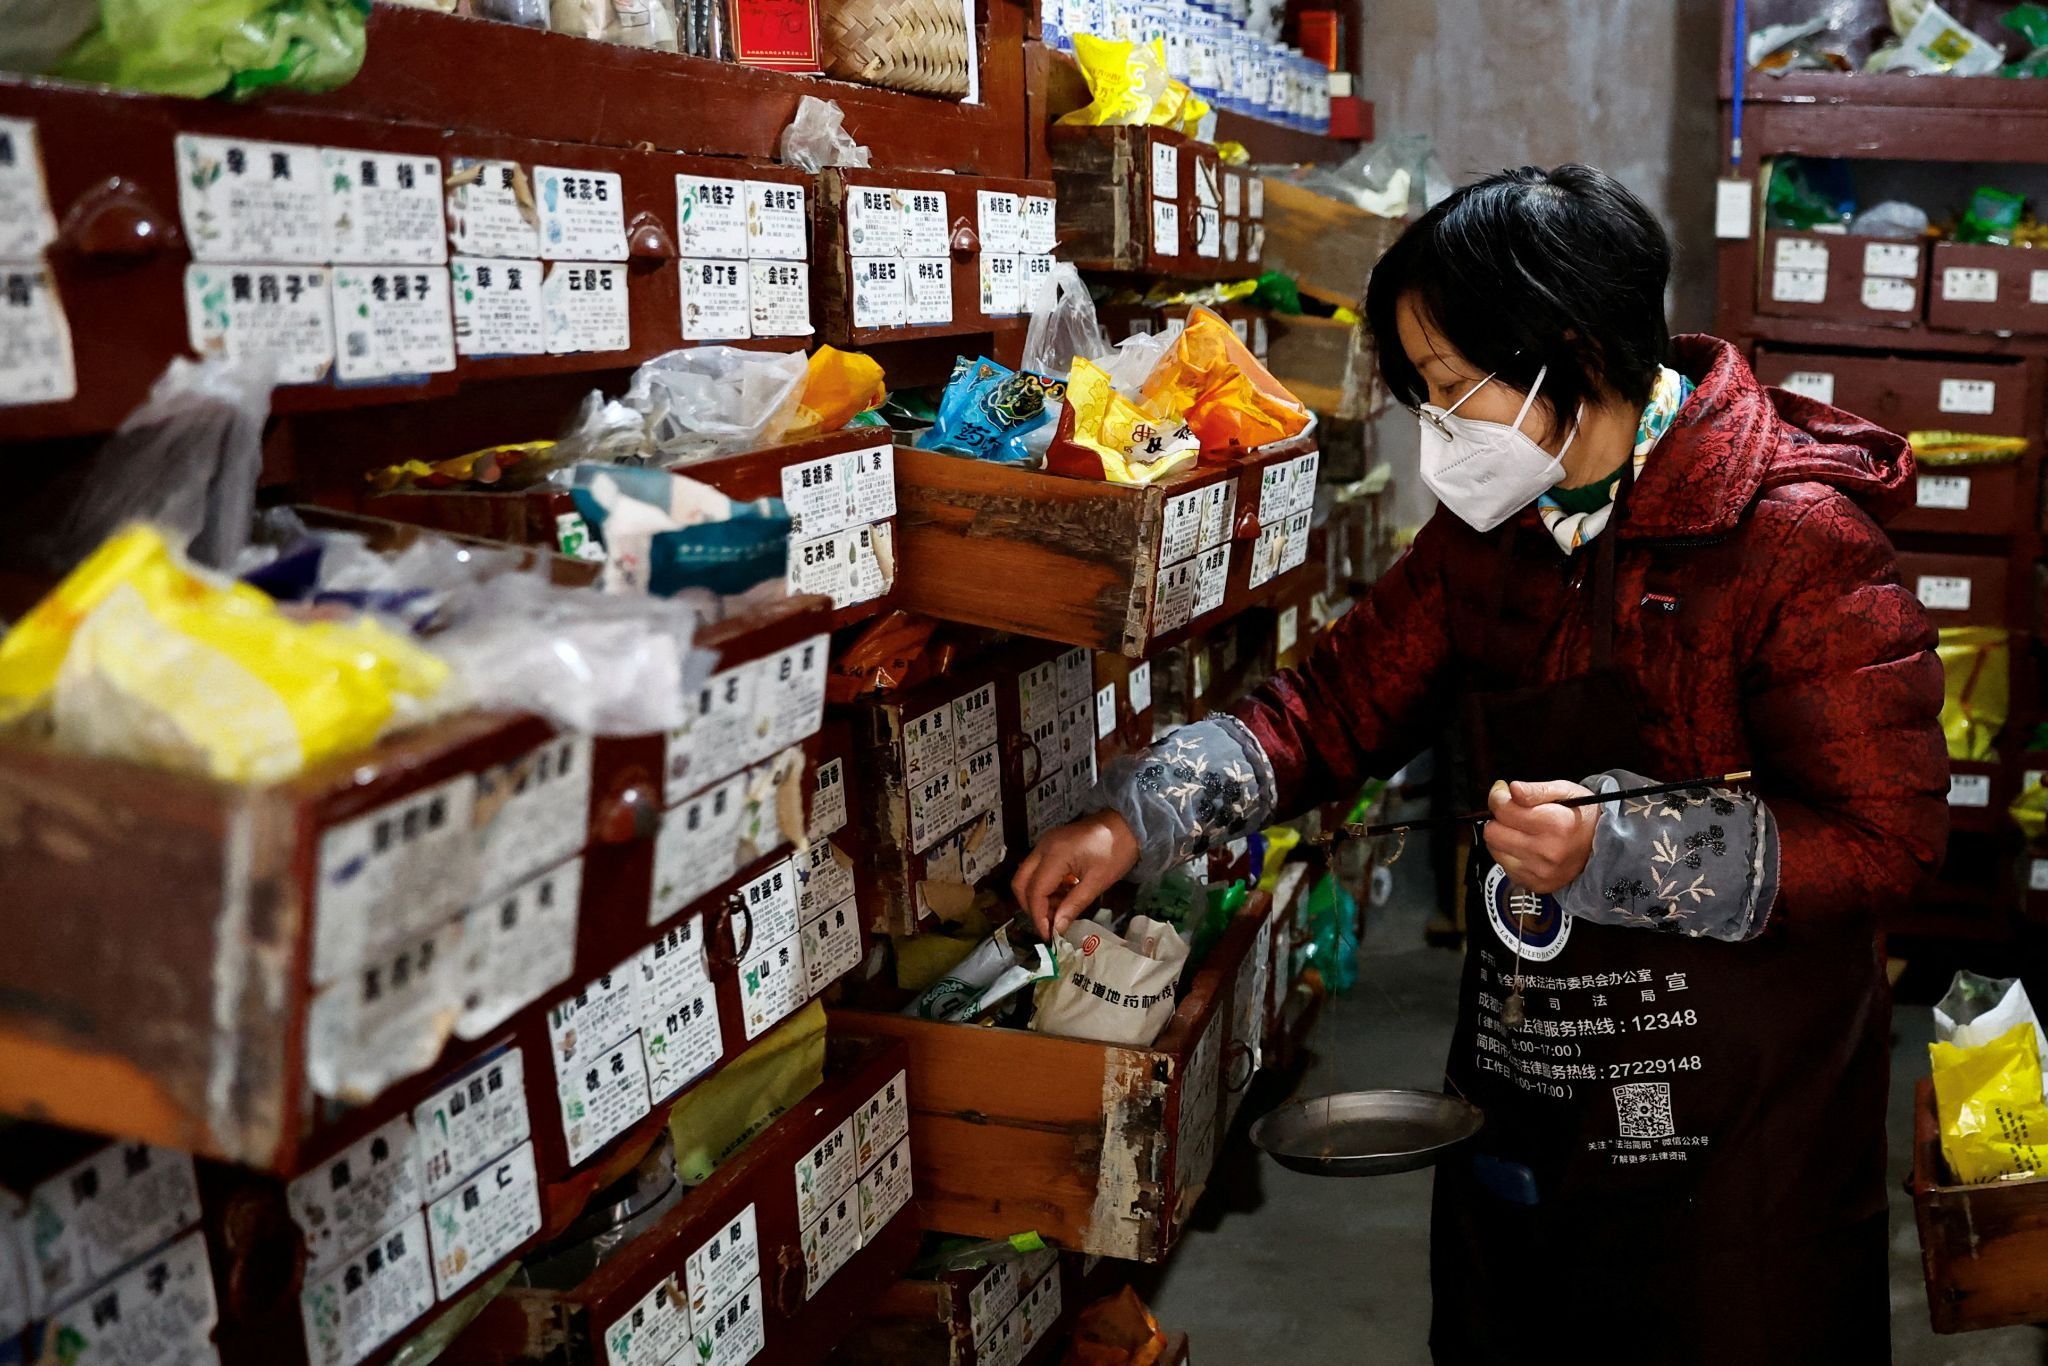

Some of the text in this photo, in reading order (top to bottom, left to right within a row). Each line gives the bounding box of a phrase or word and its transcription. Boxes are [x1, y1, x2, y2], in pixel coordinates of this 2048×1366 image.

[802, 463, 833, 488] 延胡索
[857, 452, 882, 474] 儿茶
[804, 540, 835, 566] 石决明
[816, 764, 840, 791] 茴香
[924, 774, 950, 802] 女贞子
[811, 843, 837, 868] 五灵
[1665, 972, 1689, 992] 宣
[666, 997, 704, 1035] 竹节参
[870, 1084, 895, 1119] 肉桂
